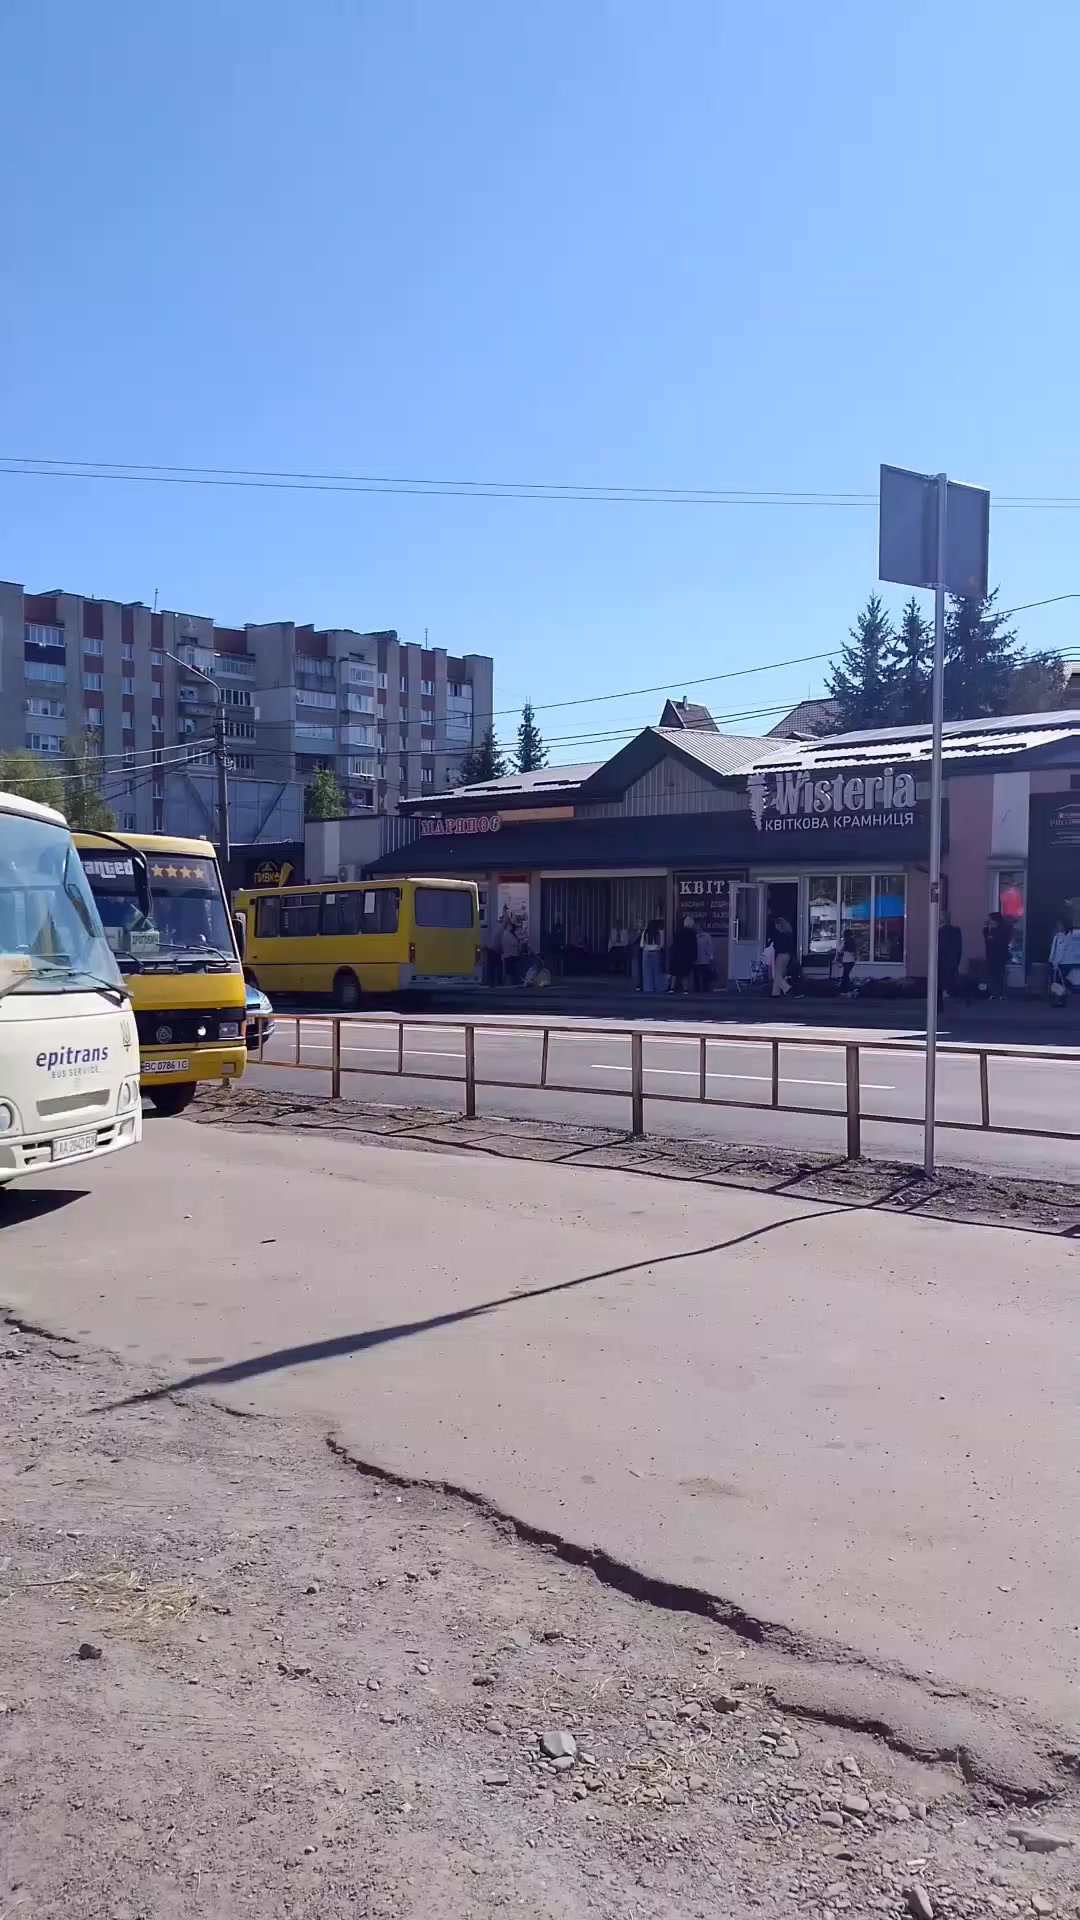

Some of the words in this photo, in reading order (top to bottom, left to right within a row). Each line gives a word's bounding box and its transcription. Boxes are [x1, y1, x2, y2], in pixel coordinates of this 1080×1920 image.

[771, 767, 918, 815] Wisteria
[765, 817, 829, 831] КВІТКОВА
[833, 813, 914, 828] КРАМНИЦЯ
[36, 1046, 108, 1071] epitrans
[157, 1061, 176, 1070] 0786
[51, 1069, 66, 1079] BUS
[69, 1065, 99, 1077] SERVICE
